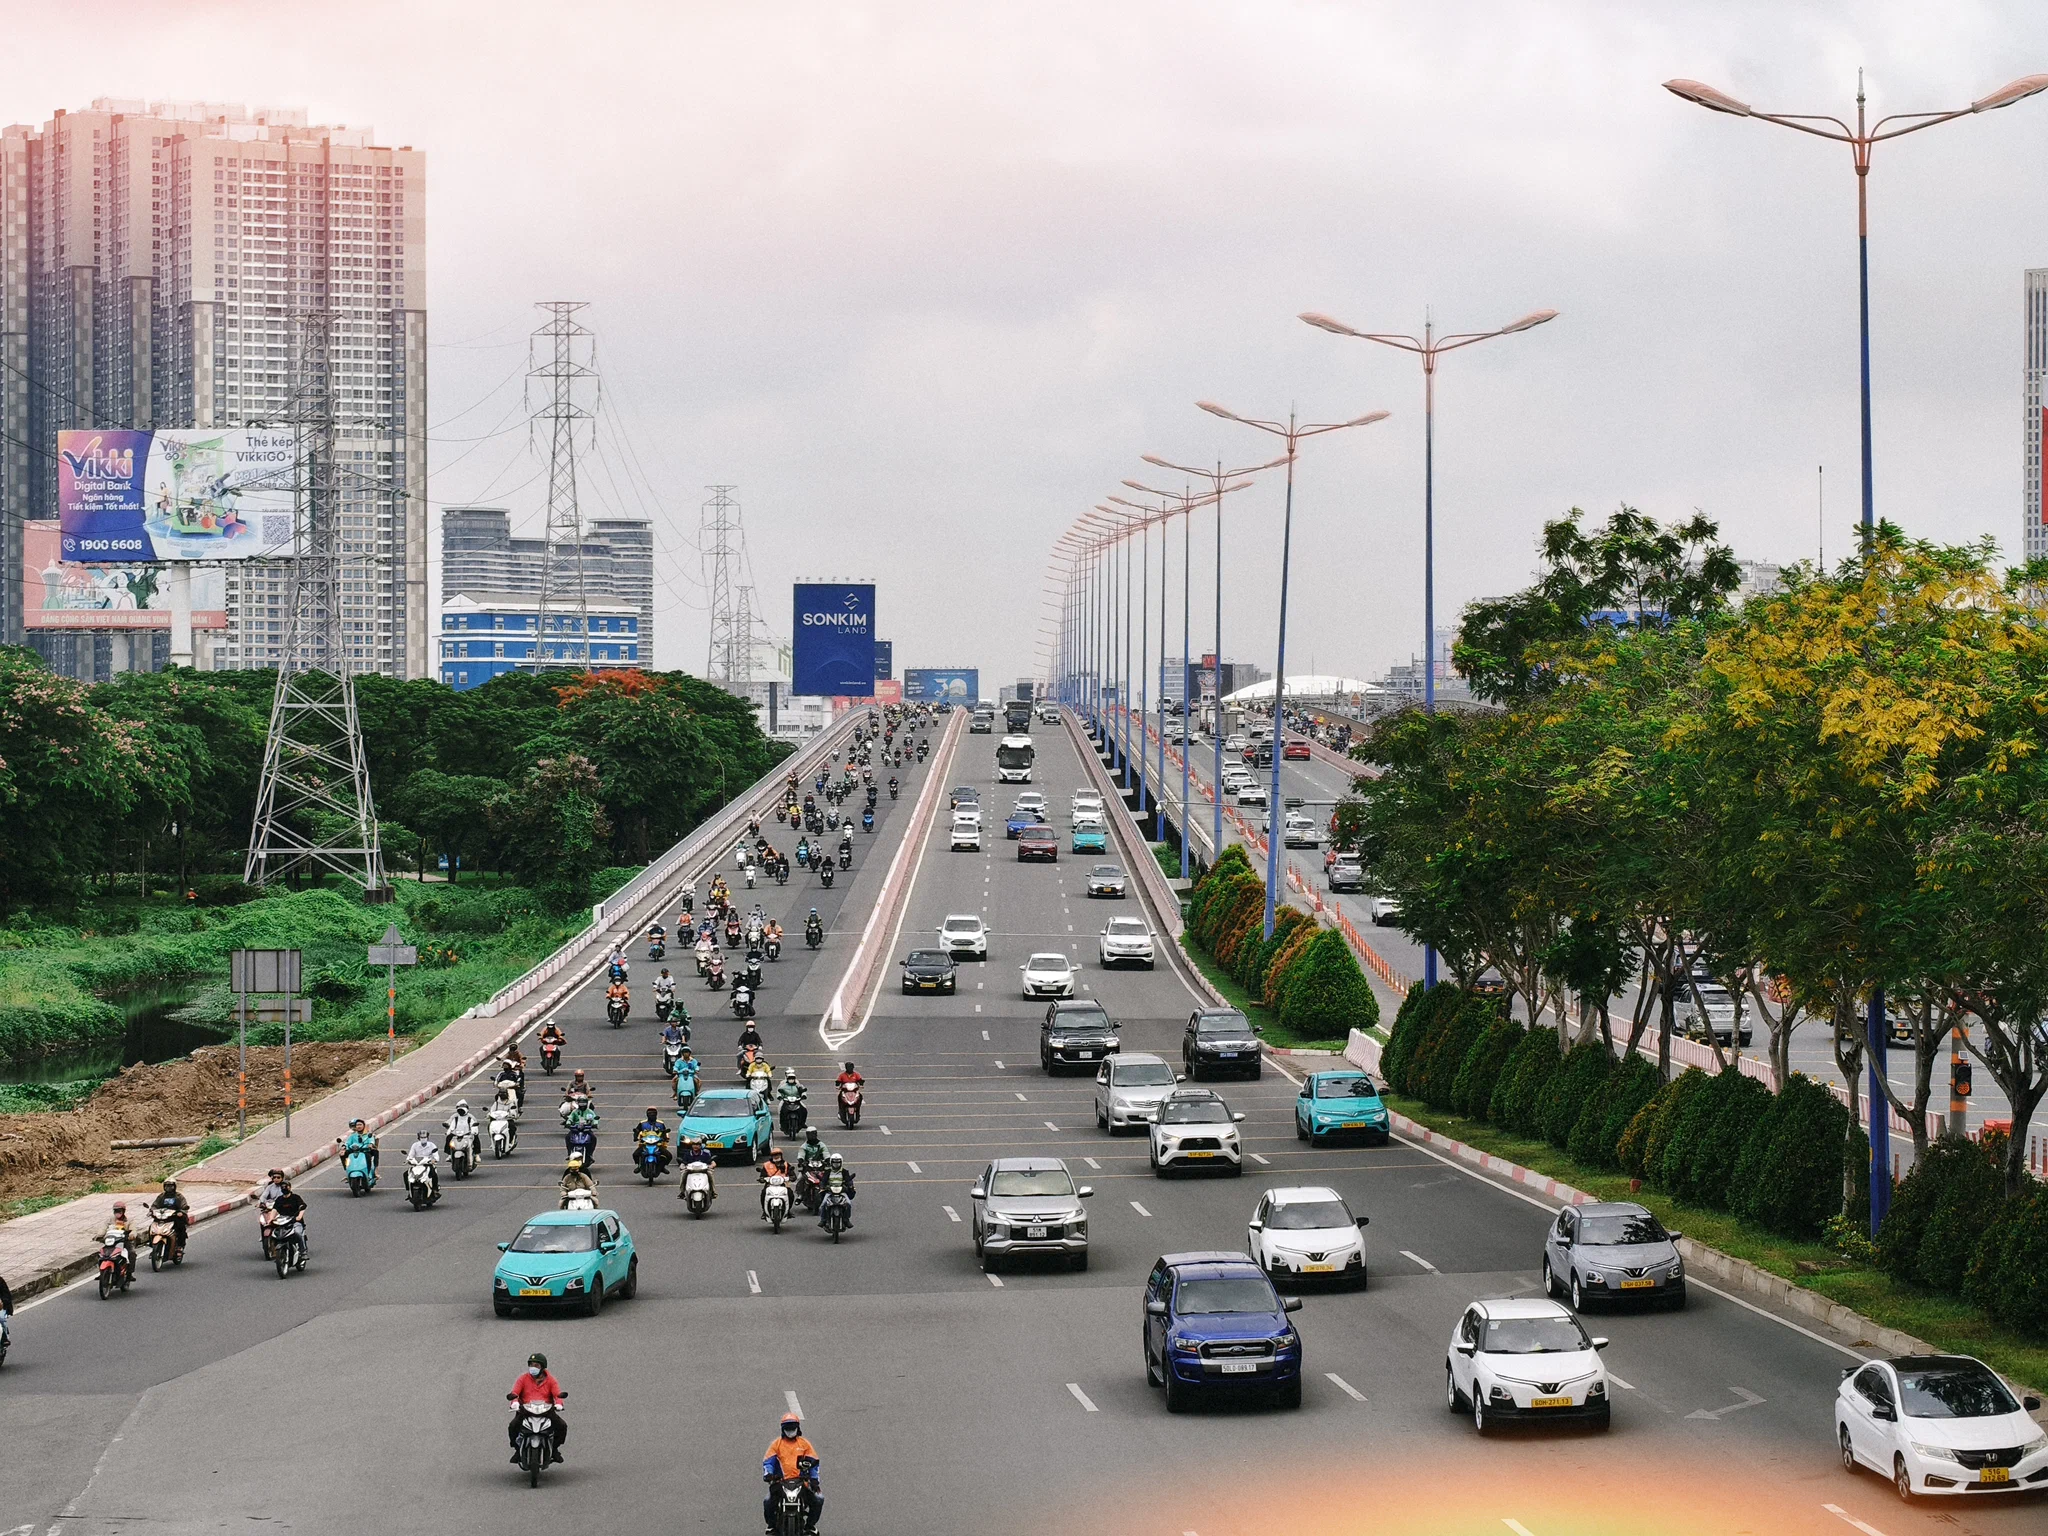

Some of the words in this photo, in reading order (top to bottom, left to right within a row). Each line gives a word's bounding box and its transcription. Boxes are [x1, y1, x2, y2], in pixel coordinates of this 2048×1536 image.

[246, 435, 269, 447] Thẻ
[271, 435, 294, 449] kép
[62, 436, 134, 480] Vikki
[236, 451, 293, 462] VikkiGO+
[74, 481, 105, 493] Digital
[107, 481, 132, 491] Bank
[82, 493, 103, 503] Ngân
[104, 493, 124, 503] hàng
[104, 501, 118, 511] Tốt
[80, 540, 109, 550] 1900
[111, 540, 143, 550] 6608
[802, 613, 867, 626] SONKIM
